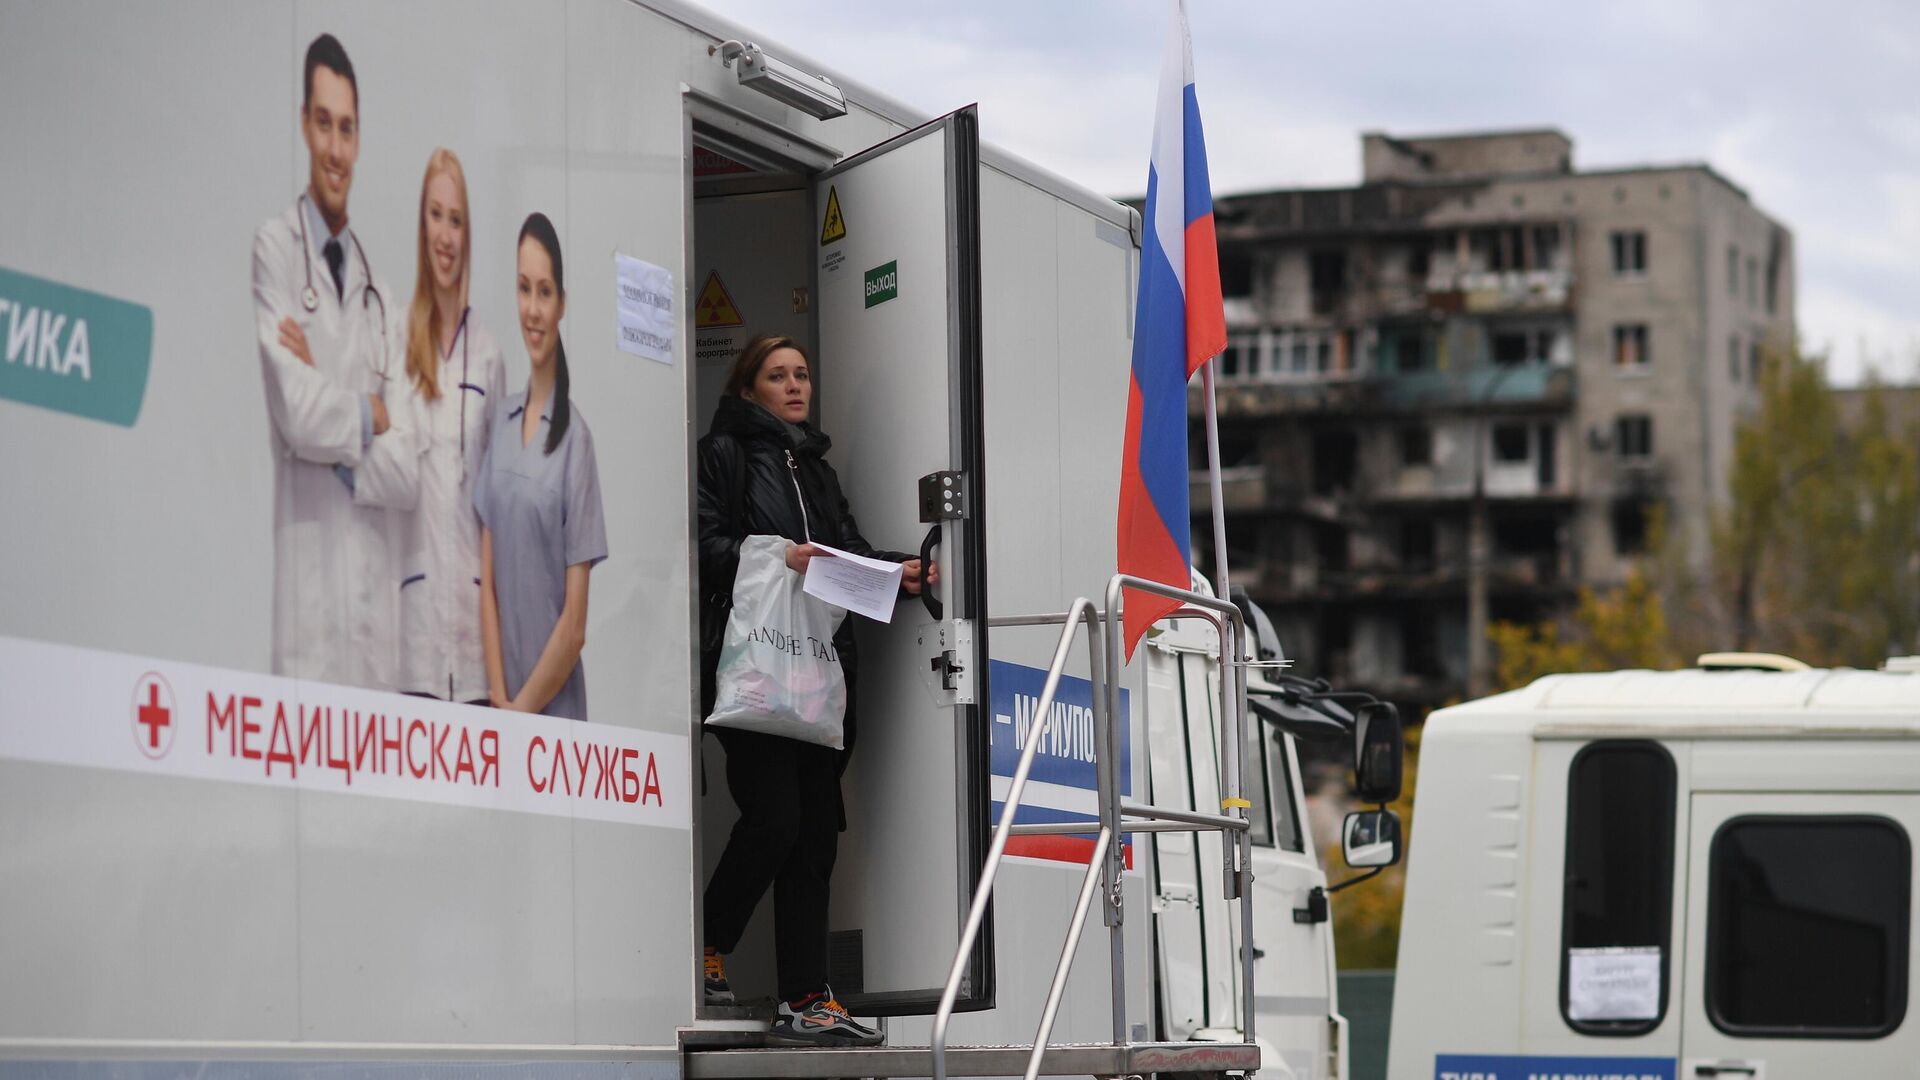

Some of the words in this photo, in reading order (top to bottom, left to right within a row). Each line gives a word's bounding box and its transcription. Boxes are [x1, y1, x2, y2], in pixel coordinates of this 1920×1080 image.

[866, 272, 896, 297] ВЫХОД
[696, 338, 733, 347] Кабинет
[206, 691, 500, 787] МЕДИЦИНСКАЯ
[527, 735, 663, 808] СЛУЖБА
